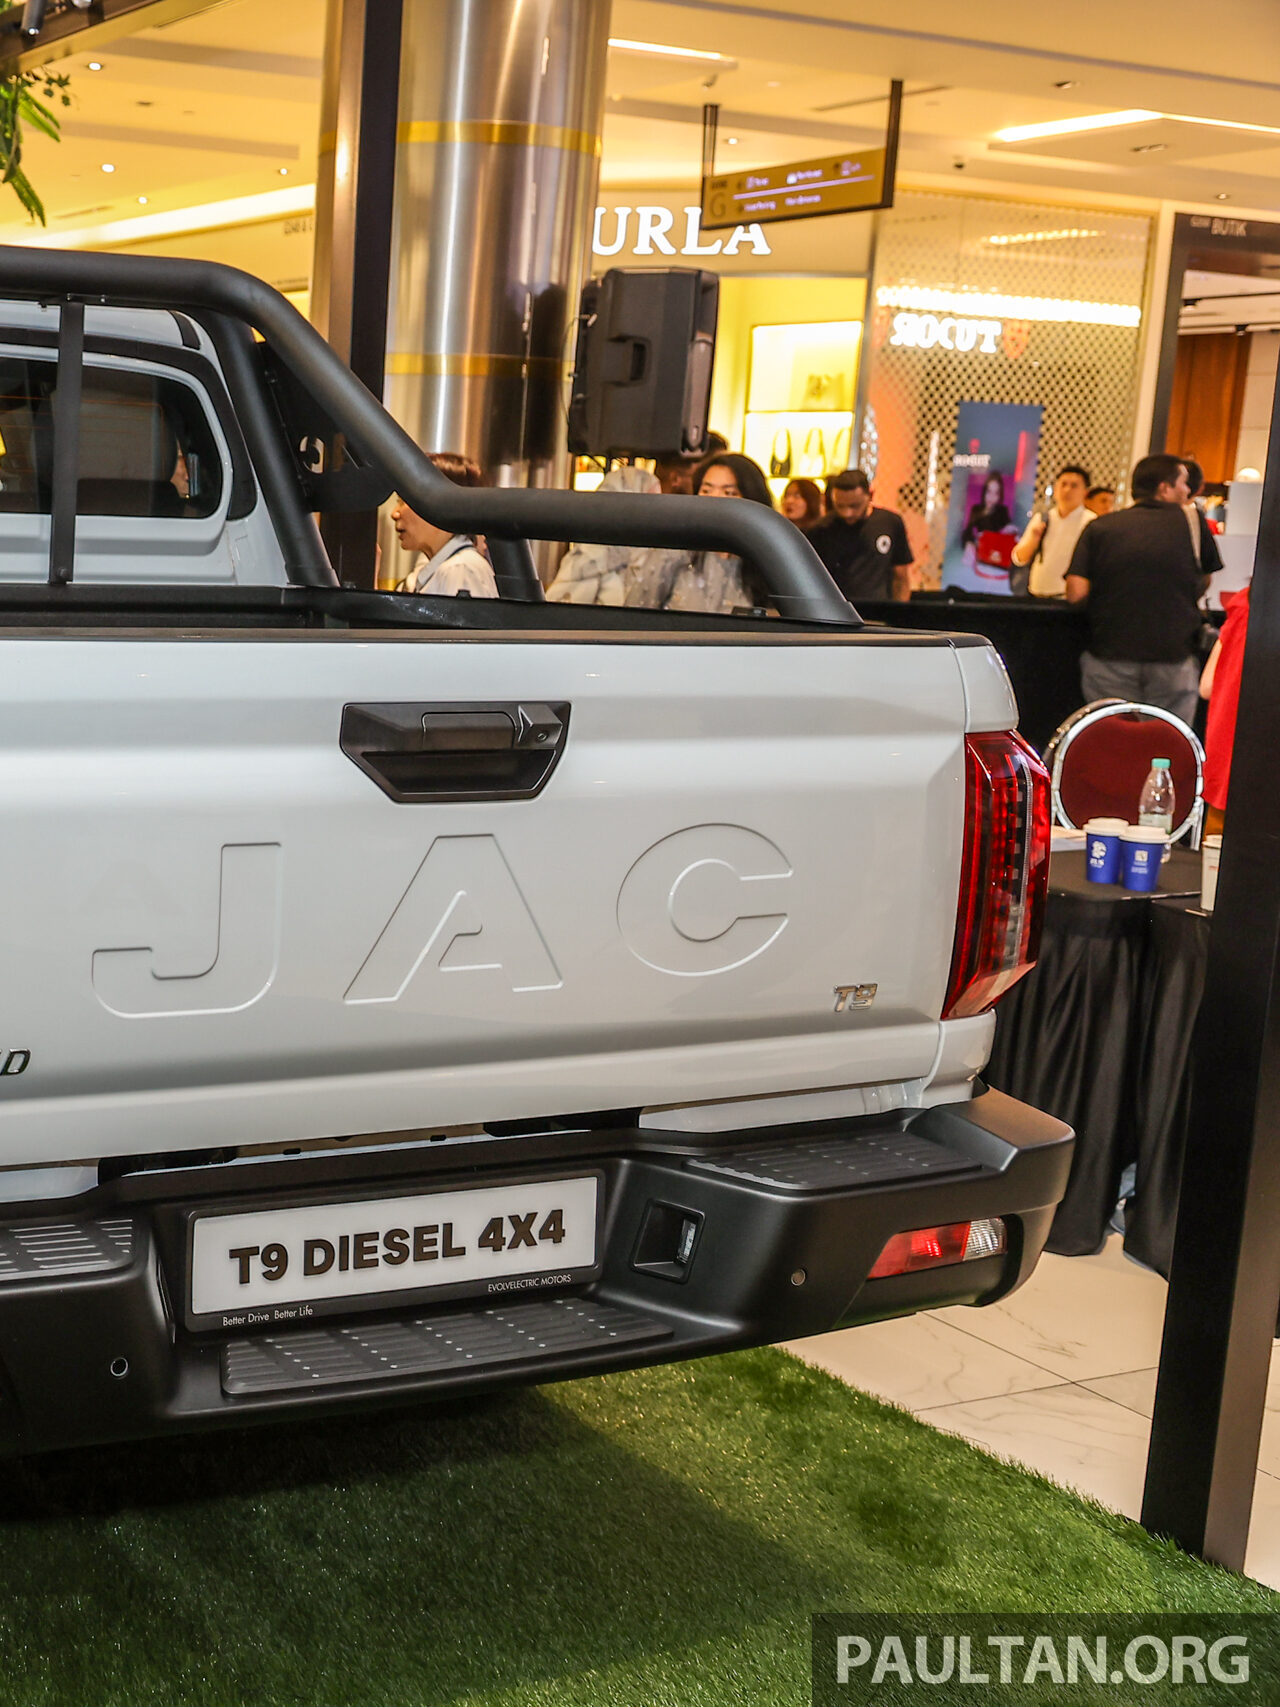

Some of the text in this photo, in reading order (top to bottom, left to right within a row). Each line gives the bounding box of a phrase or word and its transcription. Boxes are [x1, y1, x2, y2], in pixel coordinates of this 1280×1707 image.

[91, 822, 793, 1019] JAC
[833, 983, 878, 1012] T9
[228, 1209, 566, 1285] T9 DIESEL 4X4
[487, 1274, 572, 1293] EVOLVELECTRIC MOTORS
[222, 1304, 314, 1327] Better Drive Better Life
